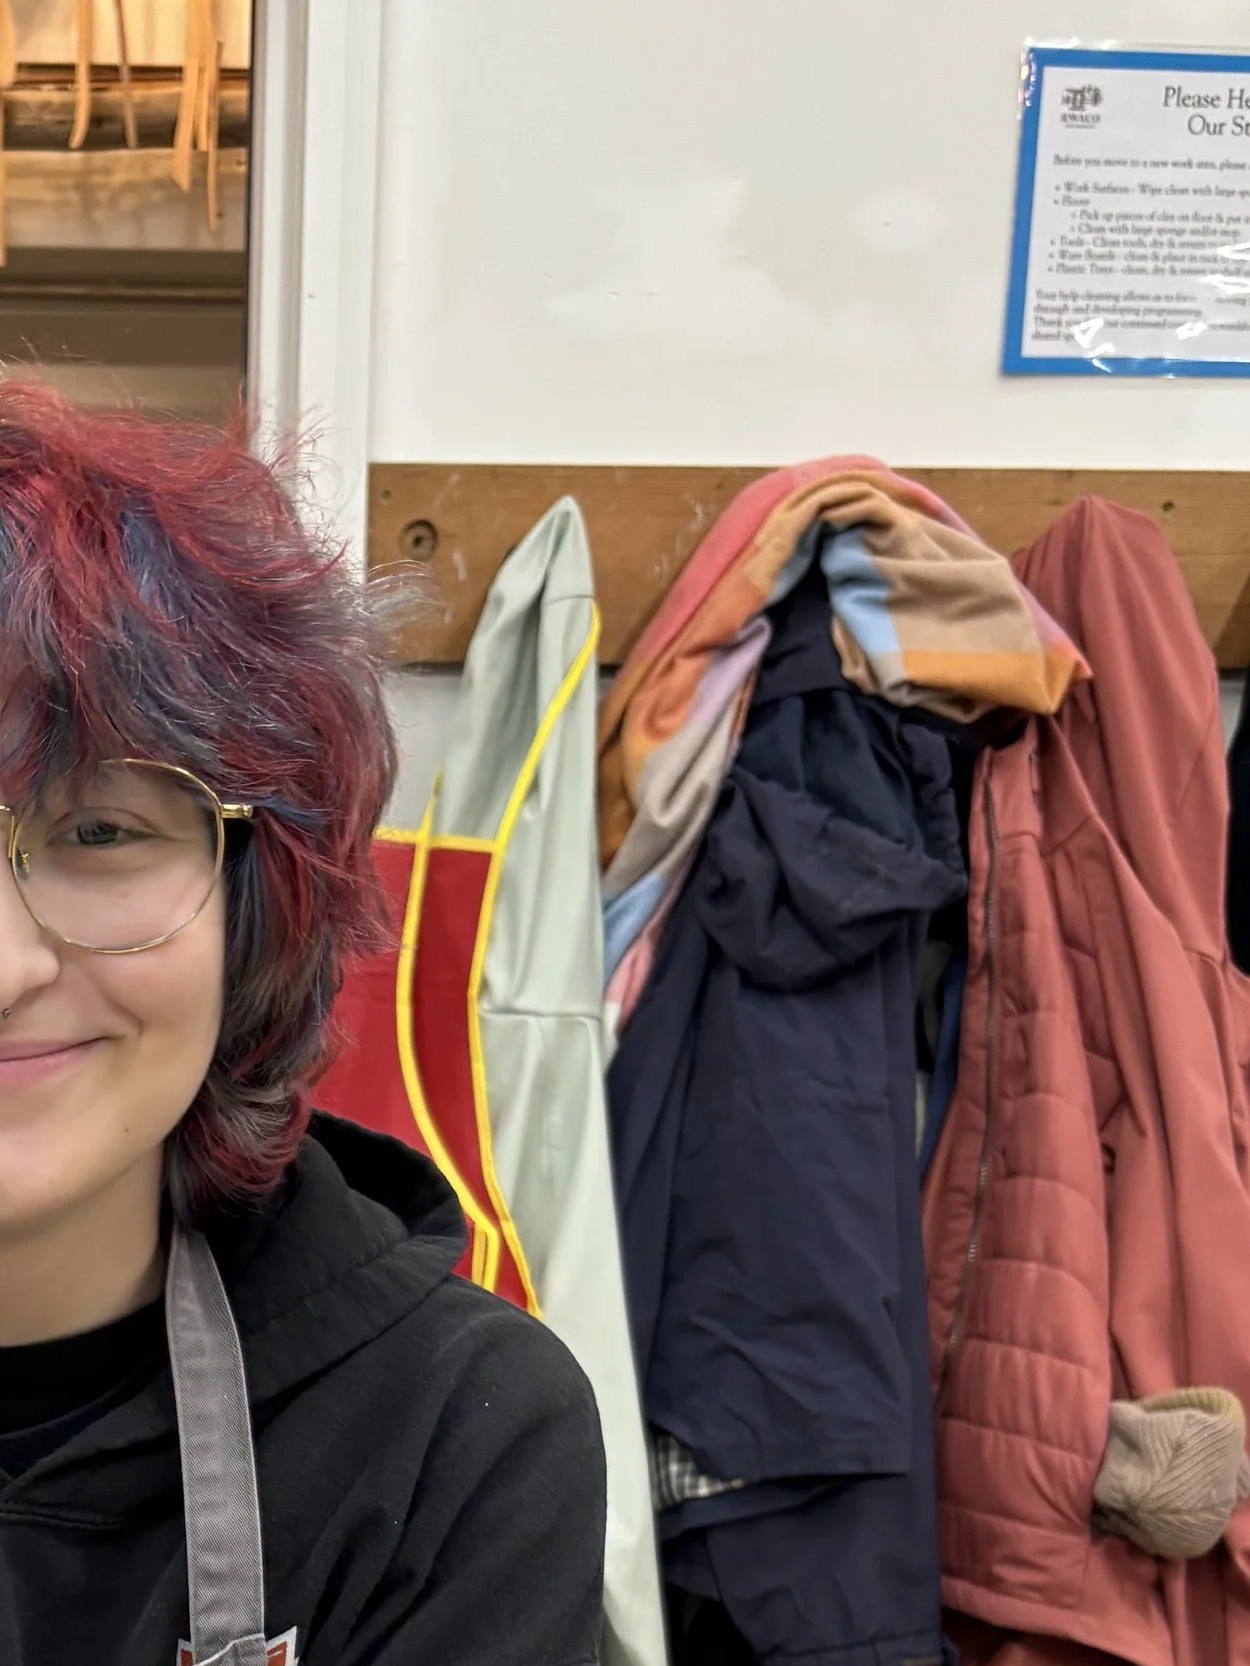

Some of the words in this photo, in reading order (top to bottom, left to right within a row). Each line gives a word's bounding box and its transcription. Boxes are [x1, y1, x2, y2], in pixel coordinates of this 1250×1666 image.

[1163, 85, 1221, 108] Please
[1227, 87, 1250, 110] He
[1187, 113, 1227, 136] Our
[1137, 182, 1164, 197] Wipe
